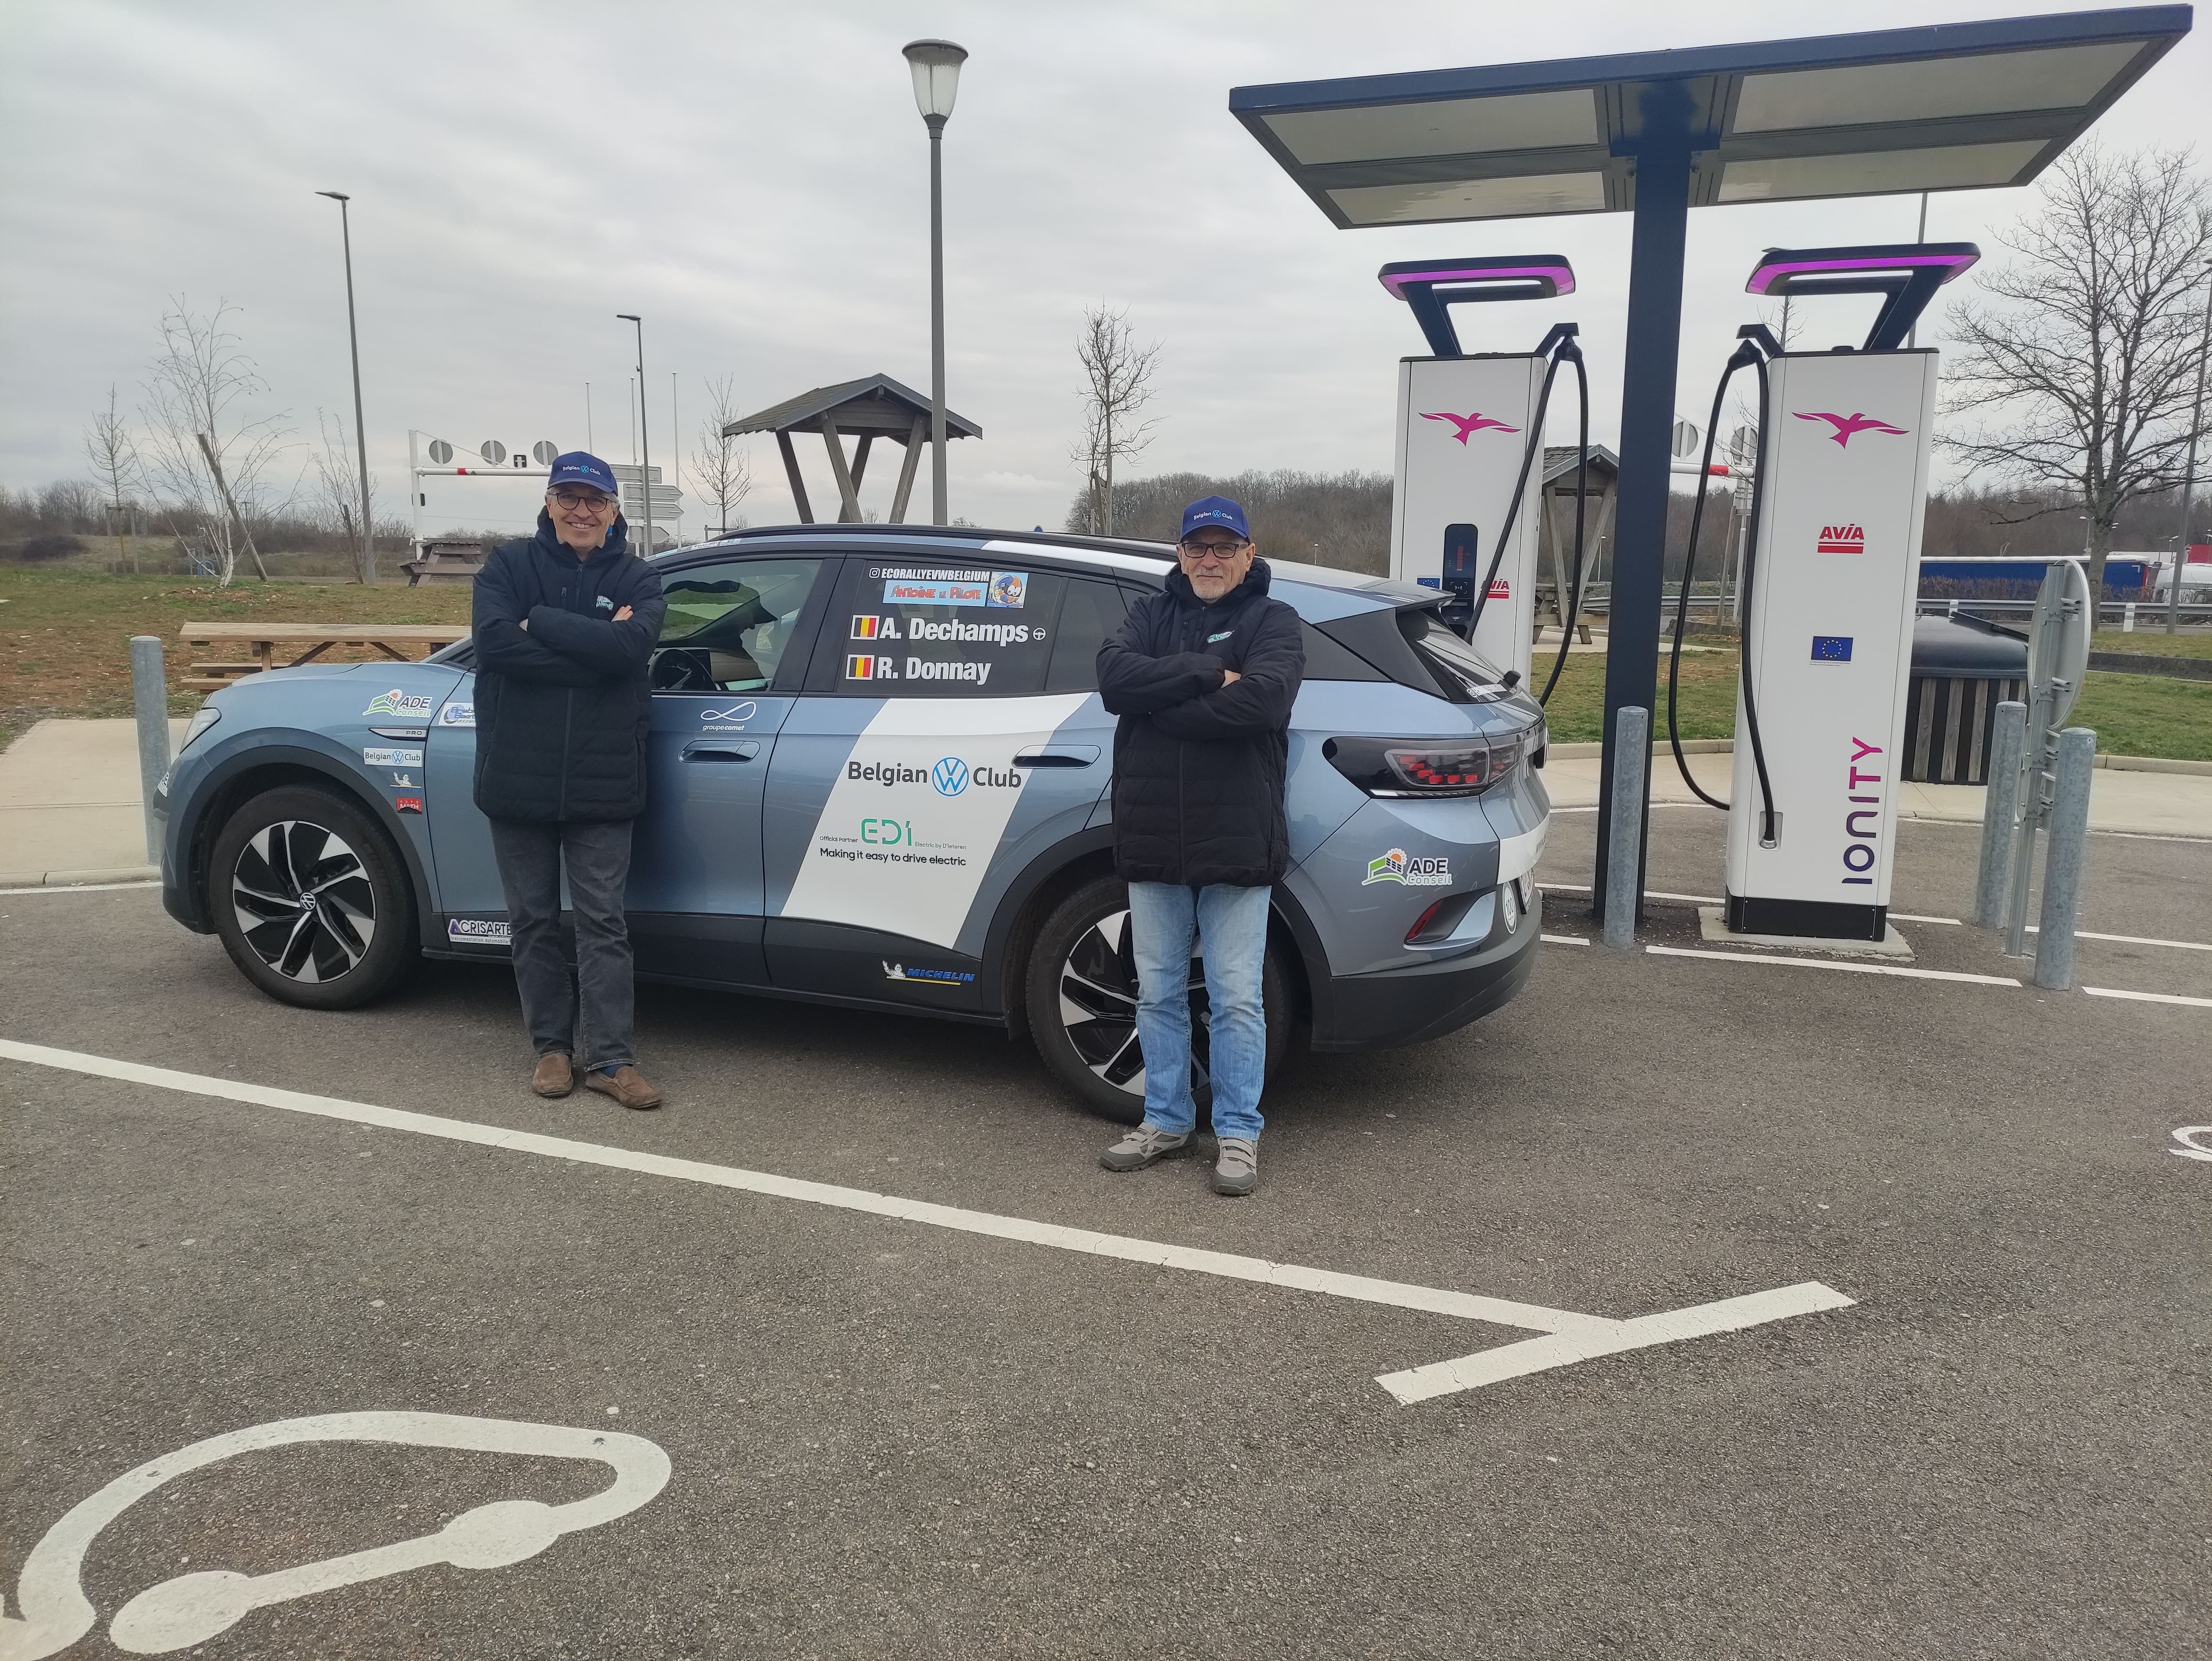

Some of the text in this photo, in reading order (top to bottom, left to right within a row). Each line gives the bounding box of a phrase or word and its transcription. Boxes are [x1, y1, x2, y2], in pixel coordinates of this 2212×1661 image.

[881, 568, 990, 582] ECORALLYEVWBELGIUM
[1481, 578, 1510, 589] VIA
[879, 617, 1029, 647] A. Dechamps
[876, 657, 992, 686] R. Donnay
[399, 697, 431, 708] ADE
[365, 752, 391, 761] Belgian
[848, 761, 927, 786] Belgian
[973, 767, 1021, 787] Club
[1841, 736, 1883, 885] IONITY
[820, 848, 966, 866] Making it easy to drive electric
[1409, 860, 1447, 874] ADE
[1408, 875, 1451, 885] Conseil
[907, 968, 975, 981] MICHELIN
